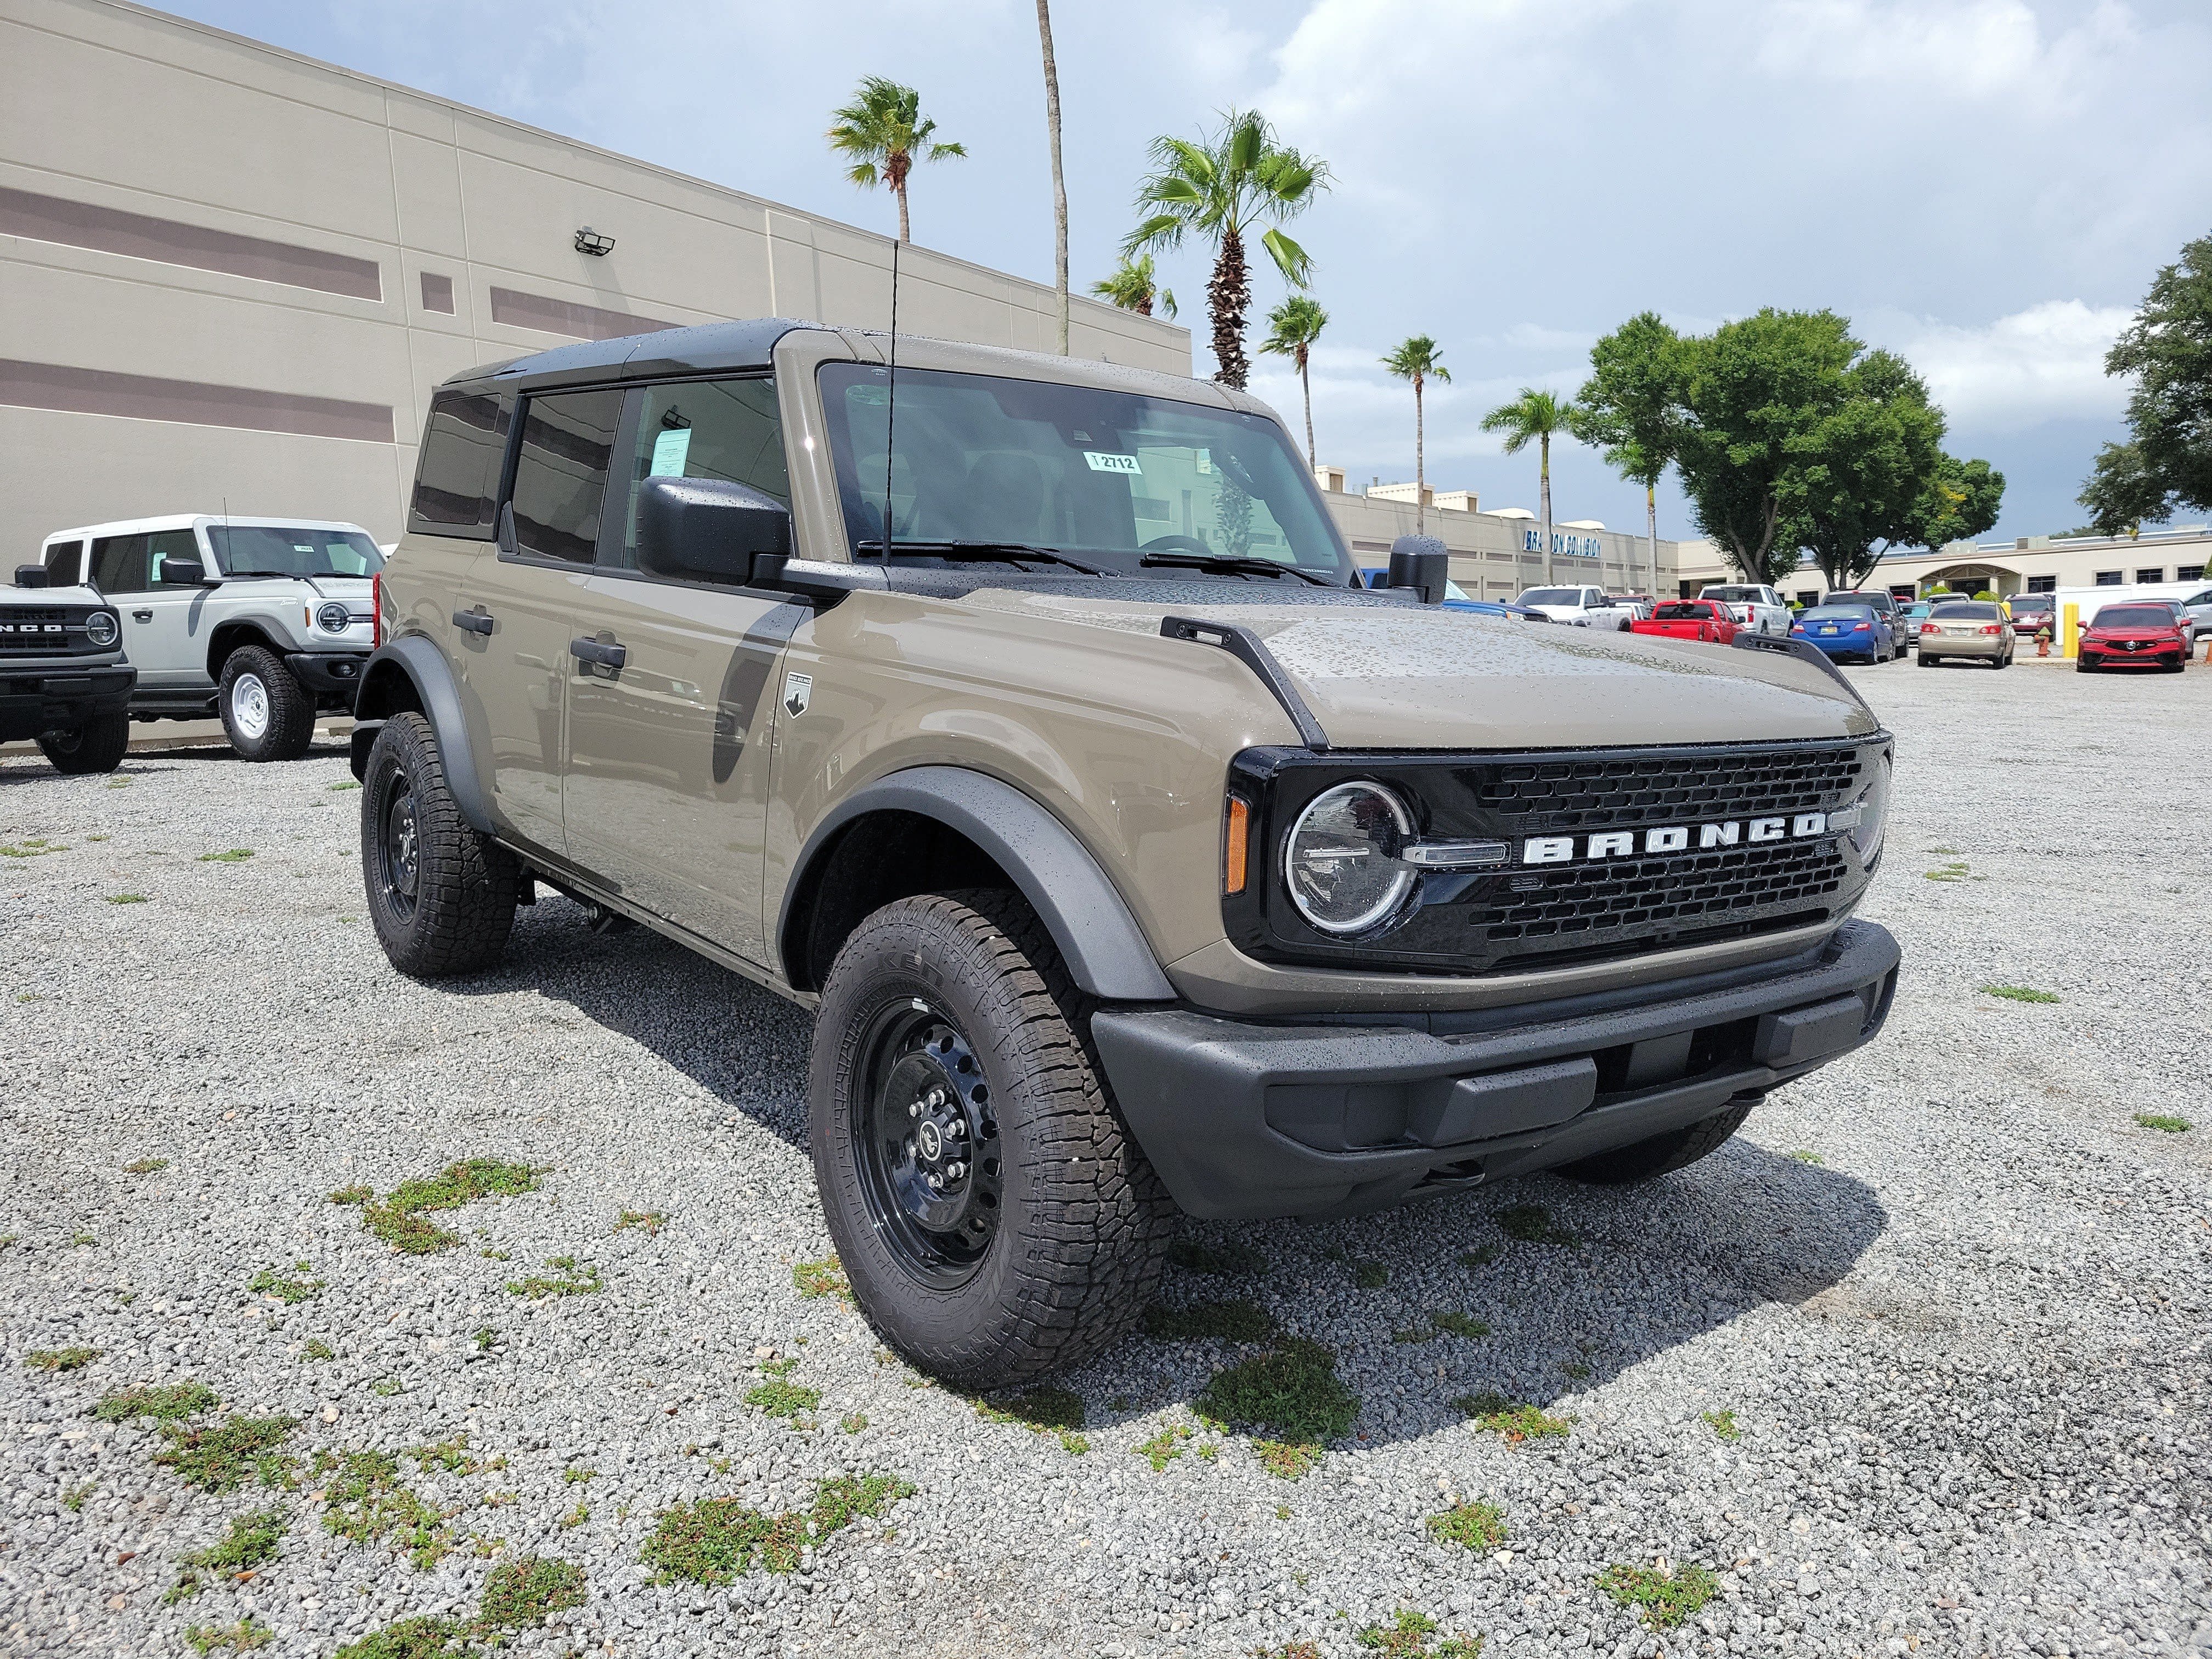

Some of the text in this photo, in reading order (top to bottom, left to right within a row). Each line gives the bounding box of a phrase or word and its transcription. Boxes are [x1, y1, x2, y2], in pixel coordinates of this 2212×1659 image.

[1101, 456, 1135, 469] 2712
[1526, 530, 1563, 553] BRAON
[1523, 812, 1826, 864] BRONCO
